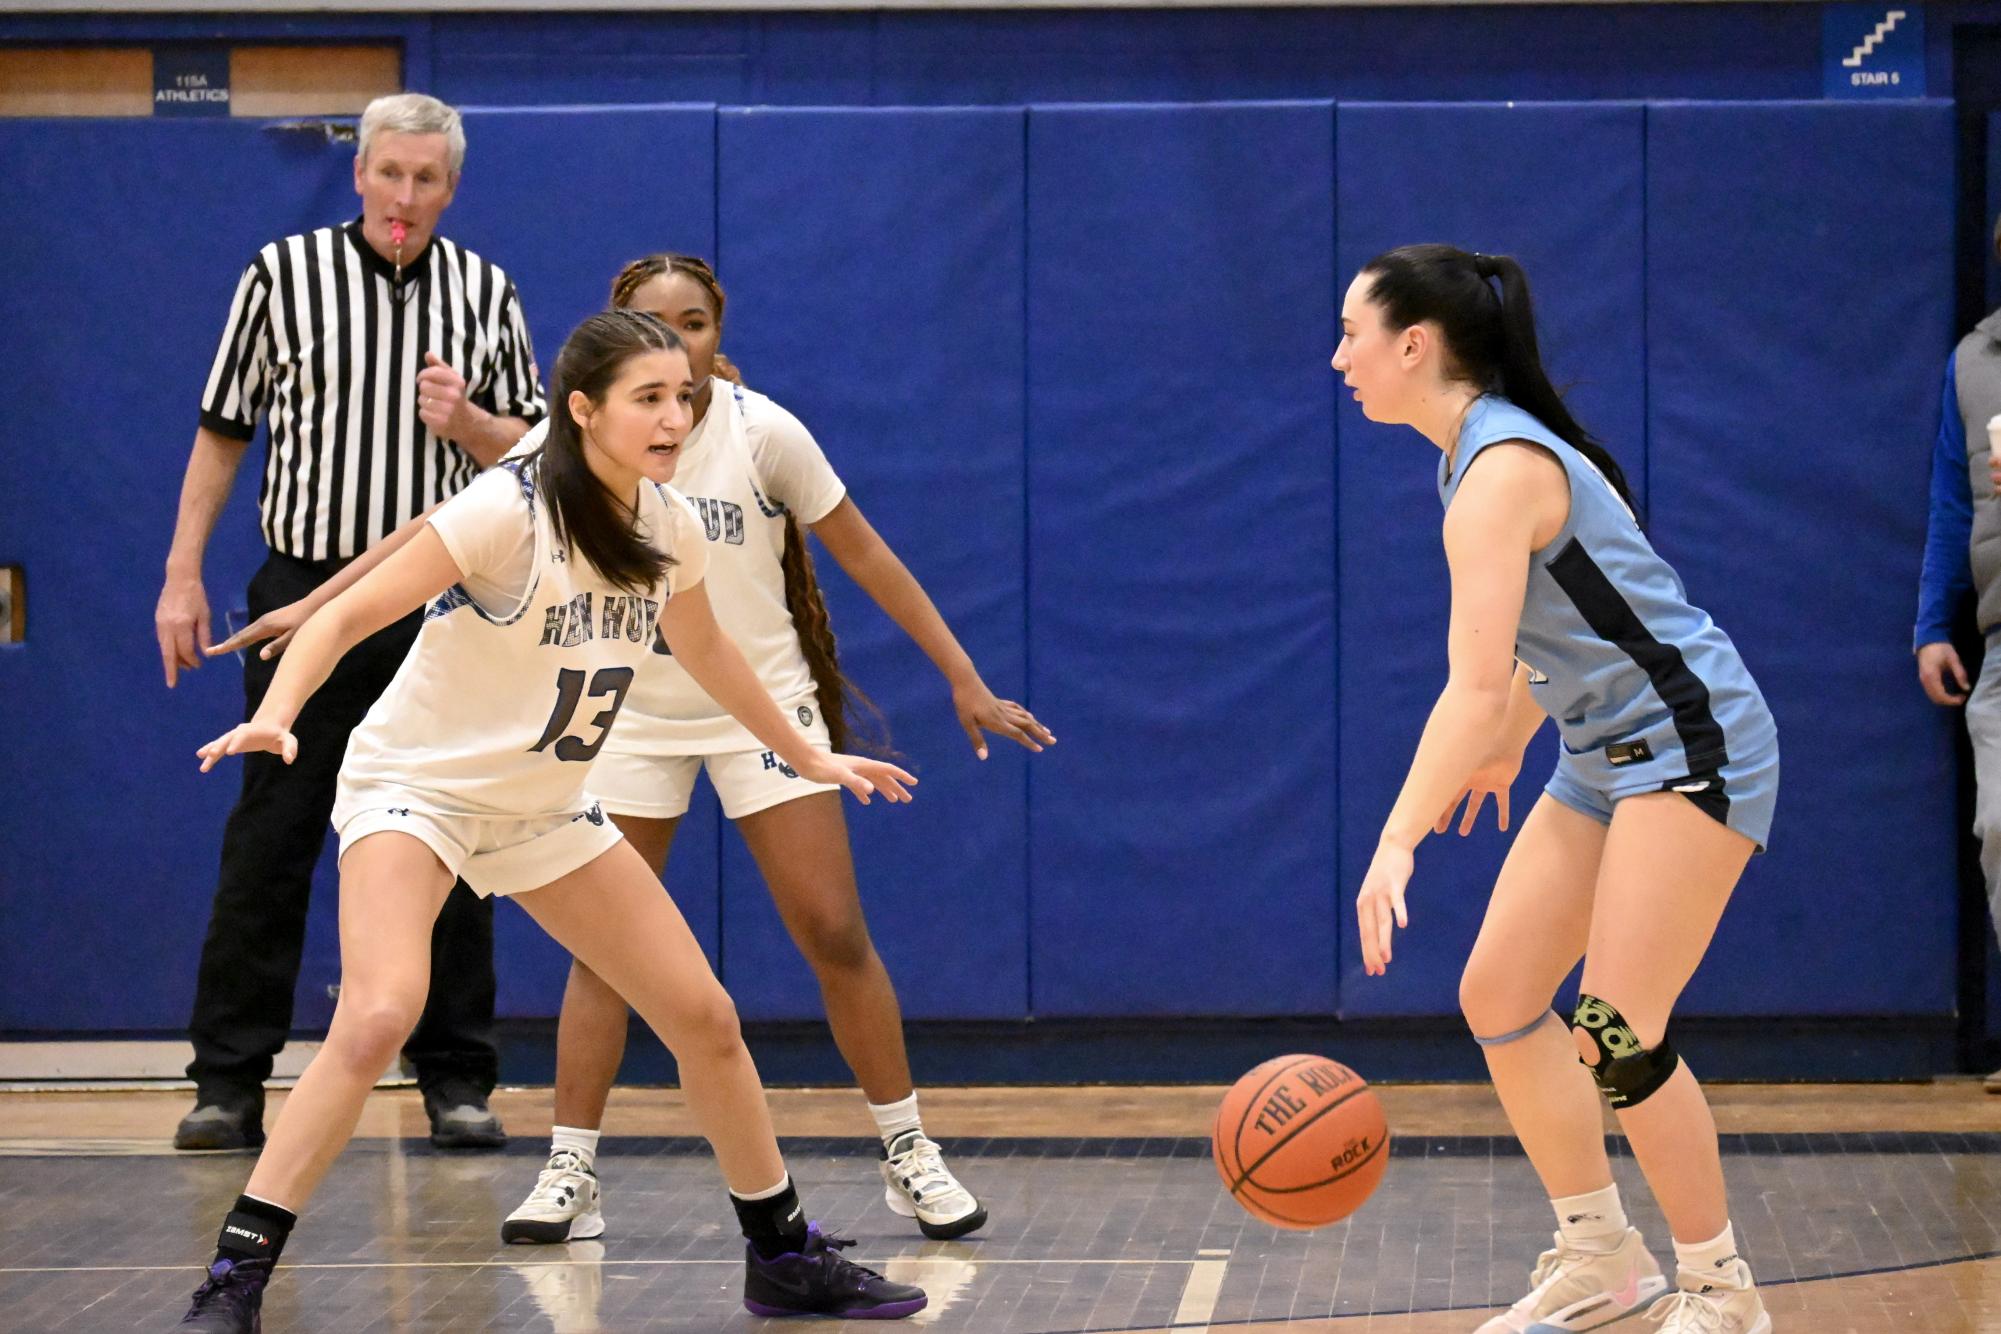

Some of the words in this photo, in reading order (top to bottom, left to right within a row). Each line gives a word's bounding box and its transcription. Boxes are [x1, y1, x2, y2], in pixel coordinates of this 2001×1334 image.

[155, 88, 229, 102] ATHLETICS
[1851, 71, 1888, 86] STAIR
[686, 497, 744, 546] UD
[539, 592, 593, 647] HEN
[526, 666, 634, 762] 13
[1254, 1084, 1307, 1136] THE
[1330, 1136, 1370, 1172] ROCK
